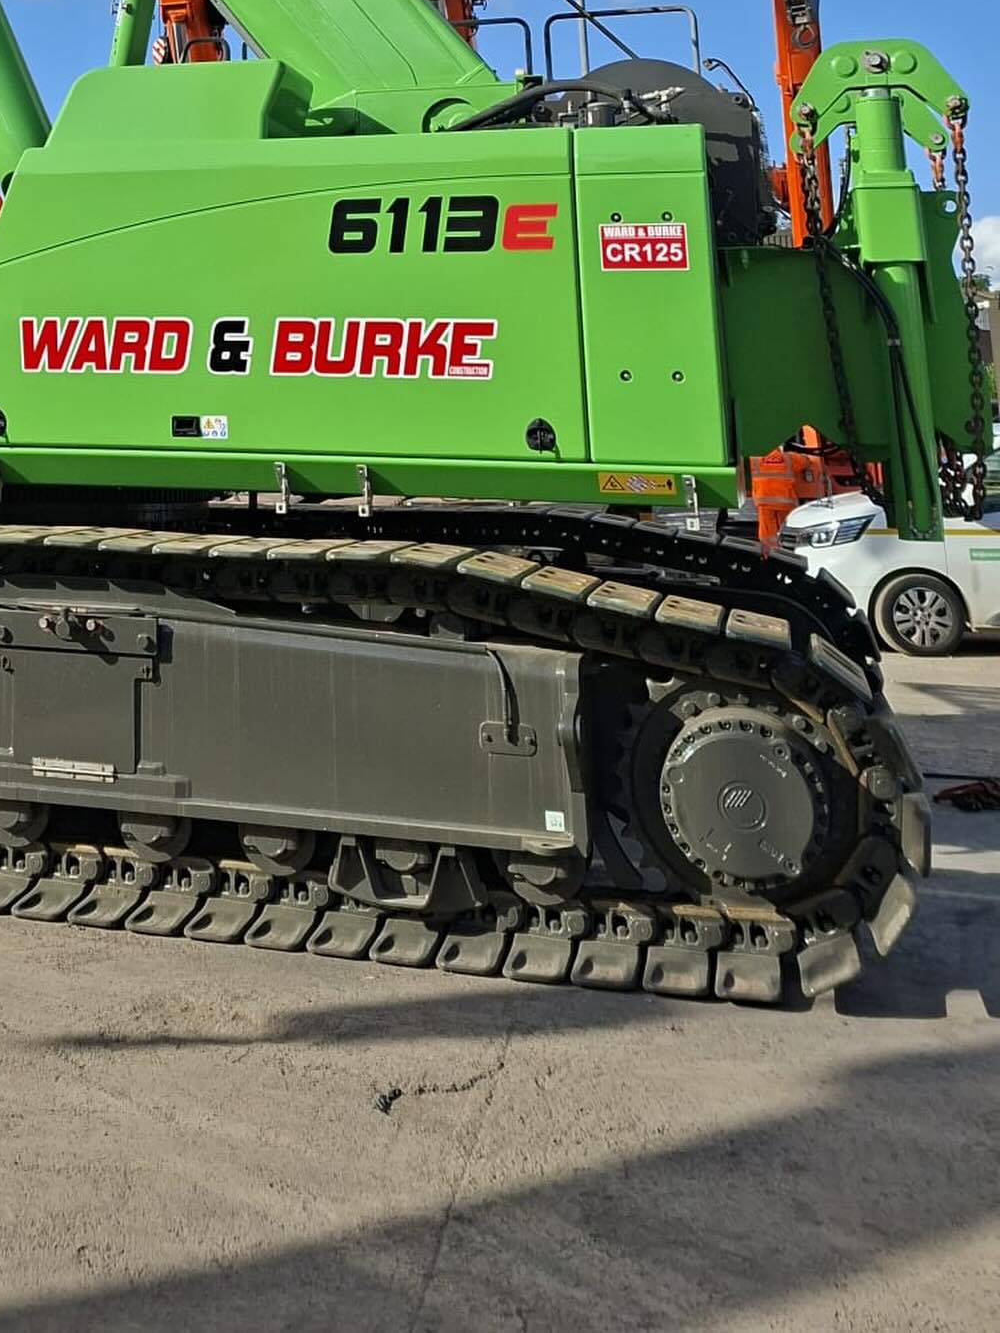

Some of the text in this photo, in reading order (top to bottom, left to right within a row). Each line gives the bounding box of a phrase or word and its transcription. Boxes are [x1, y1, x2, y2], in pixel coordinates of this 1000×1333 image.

[329, 195, 558, 254] 6113E
[603, 225, 683, 237] WARD & BURKE
[606, 243, 683, 262] CR125
[20, 317, 497, 379] WARD & BURKE
